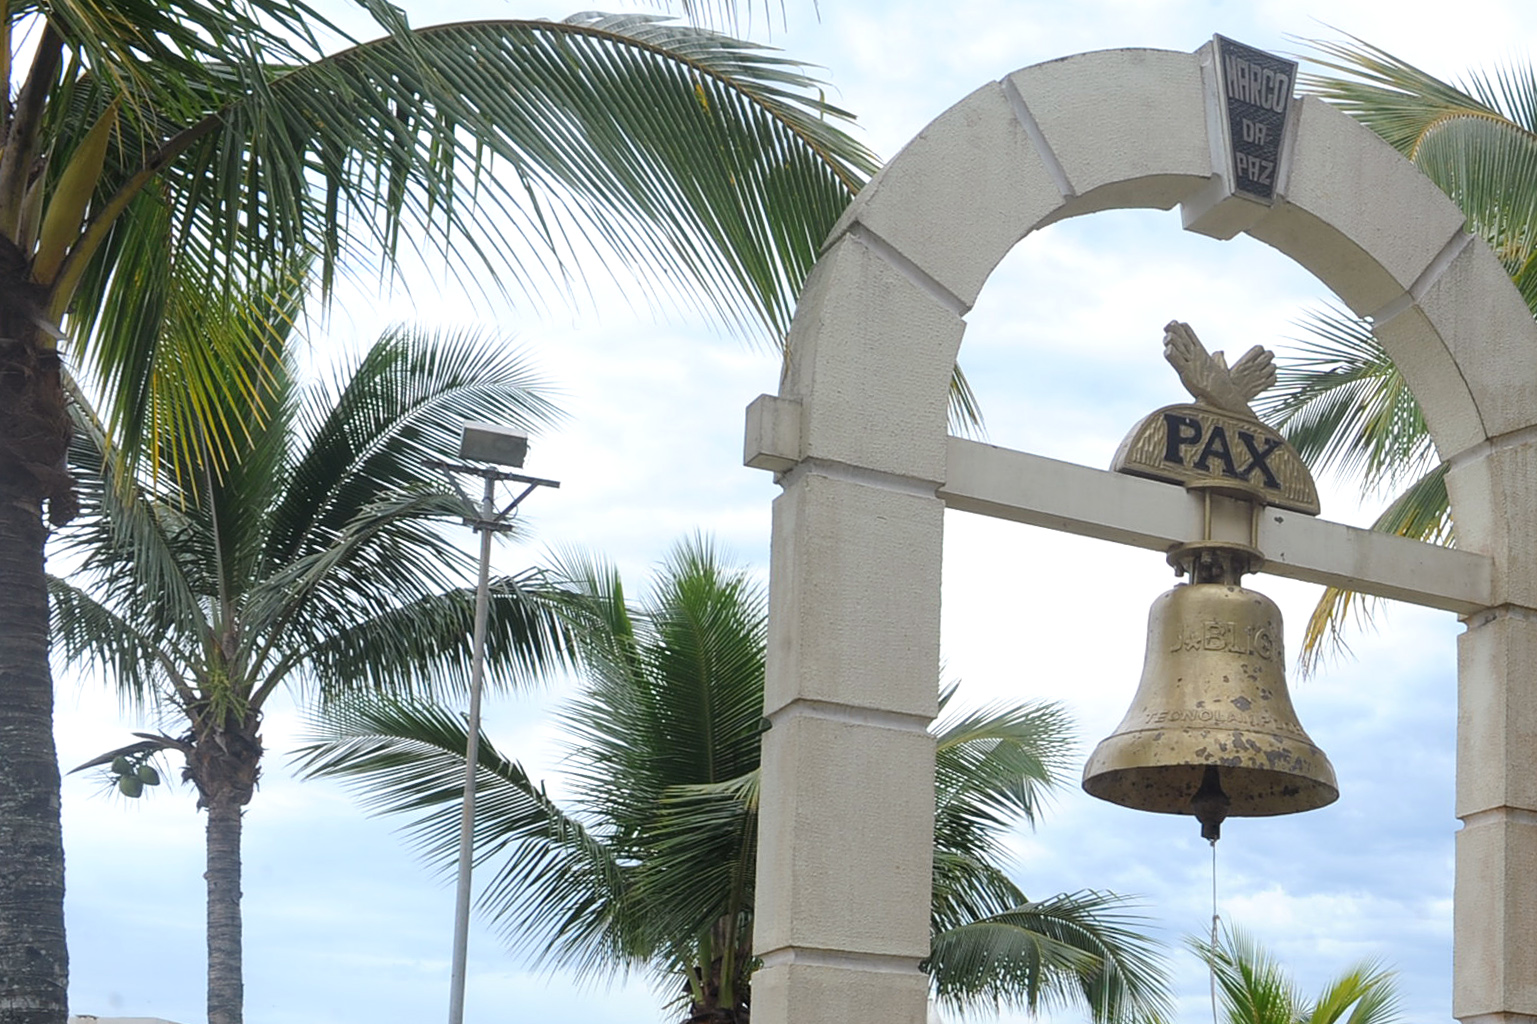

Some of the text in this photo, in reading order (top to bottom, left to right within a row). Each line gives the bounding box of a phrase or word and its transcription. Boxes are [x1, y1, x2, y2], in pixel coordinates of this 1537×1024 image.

[1225, 53, 1288, 113] MARCO
[1242, 118, 1268, 145] DA
[1235, 151, 1274, 186] PAZ
[1164, 413, 1283, 488] PAX
